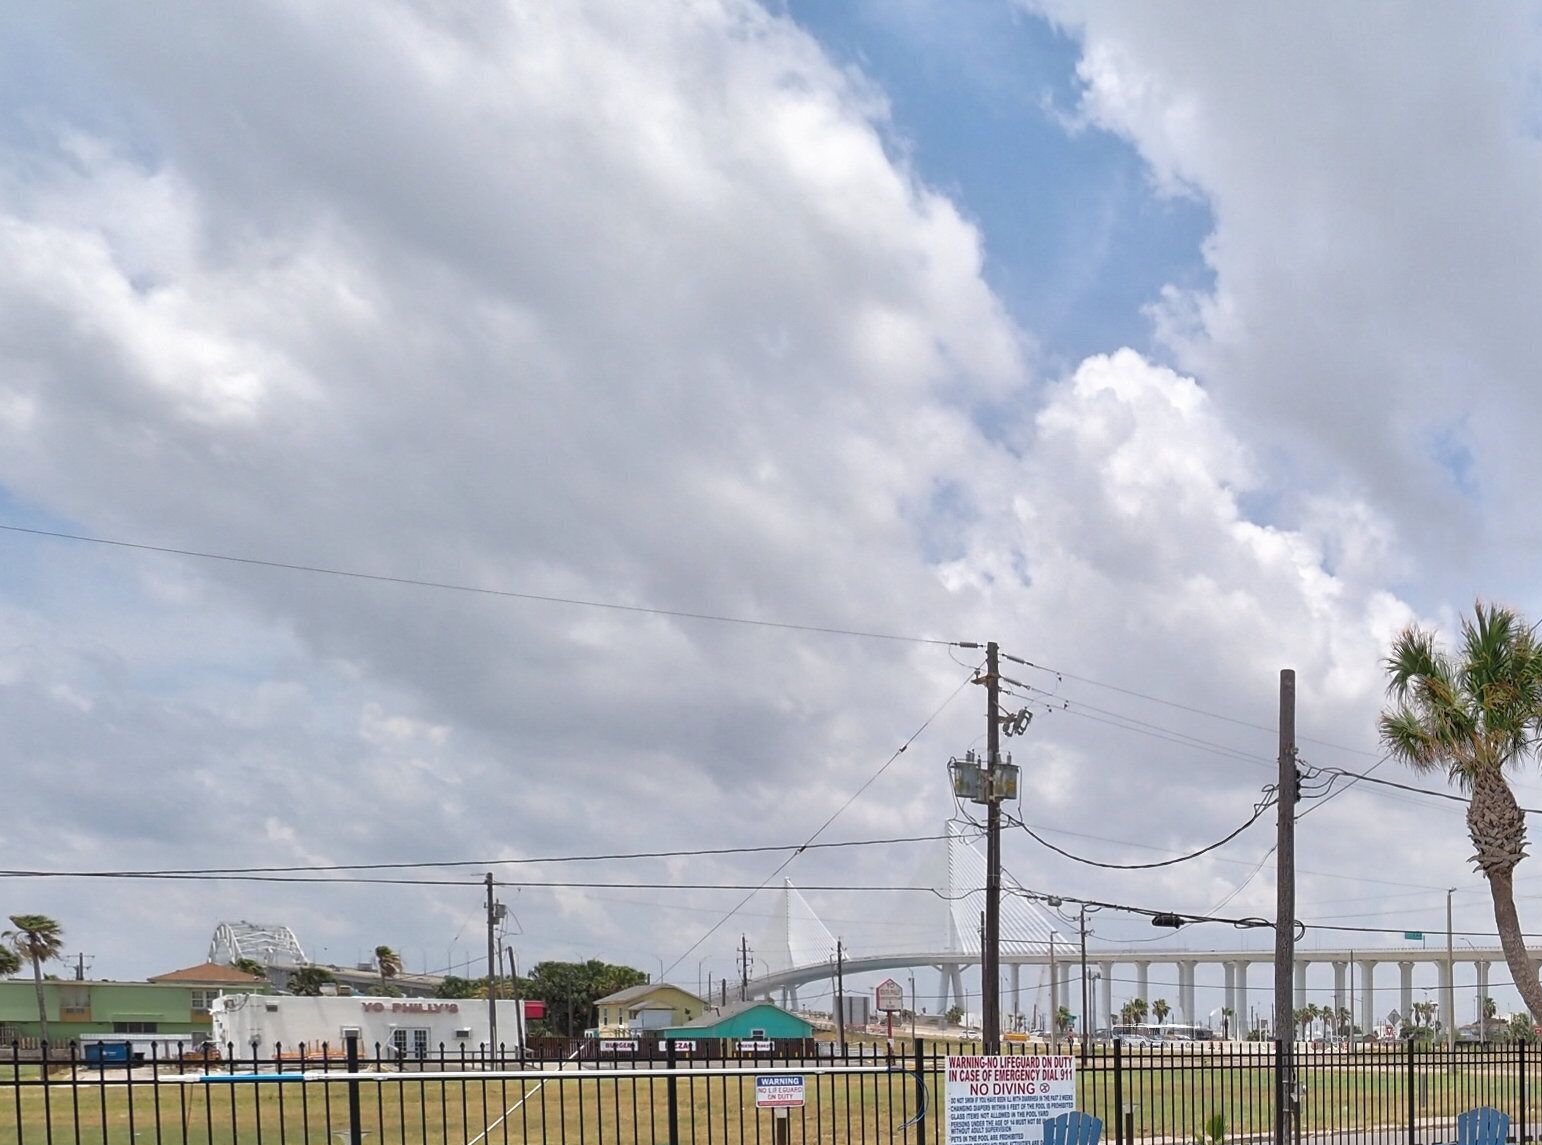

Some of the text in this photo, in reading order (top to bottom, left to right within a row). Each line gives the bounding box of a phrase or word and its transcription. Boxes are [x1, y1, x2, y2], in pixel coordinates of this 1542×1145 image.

[362, 1002, 459, 1014] YO PHILLY'S
[1000, 1056, 1040, 1068] LIFEGUARD
[1042, 1056, 1052, 1068] ON
[1054, 1056, 1072, 1068] DUTY
[949, 1069, 1072, 1082] IN CASE OF EMERGENCY DIAL 911
[970, 1082, 1035, 1096] NO DIVING
